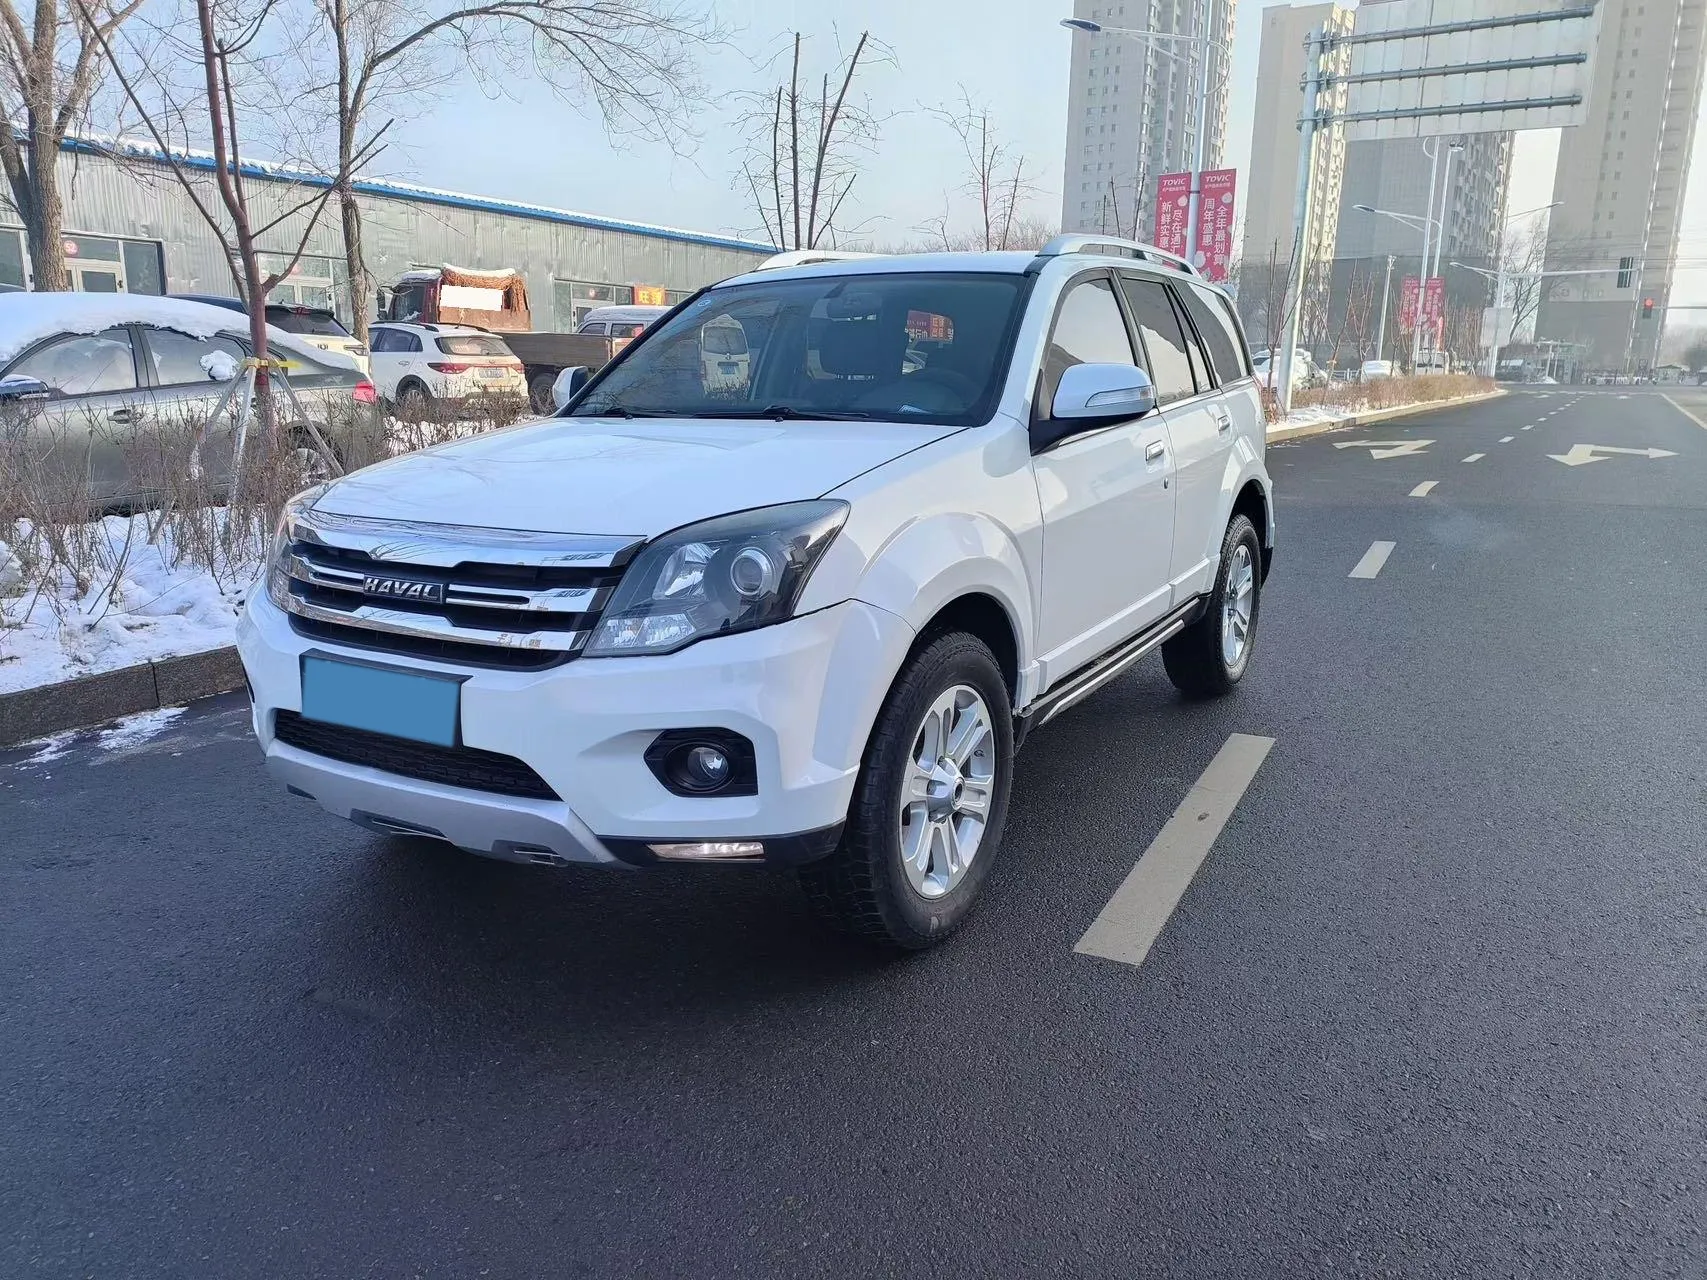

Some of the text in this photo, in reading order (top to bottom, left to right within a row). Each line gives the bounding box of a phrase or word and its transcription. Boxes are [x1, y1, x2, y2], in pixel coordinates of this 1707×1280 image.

[1163, 178, 1186, 186] TOVIC
[1205, 174, 1231, 182] TOVIC
[1160, 201, 1172, 248] 新鲜实惠
[1202, 198, 1215, 246] 周年盛惠
[1213, 205, 1227, 265] 全年最划算
[364, 577, 438, 601] HAVAL
